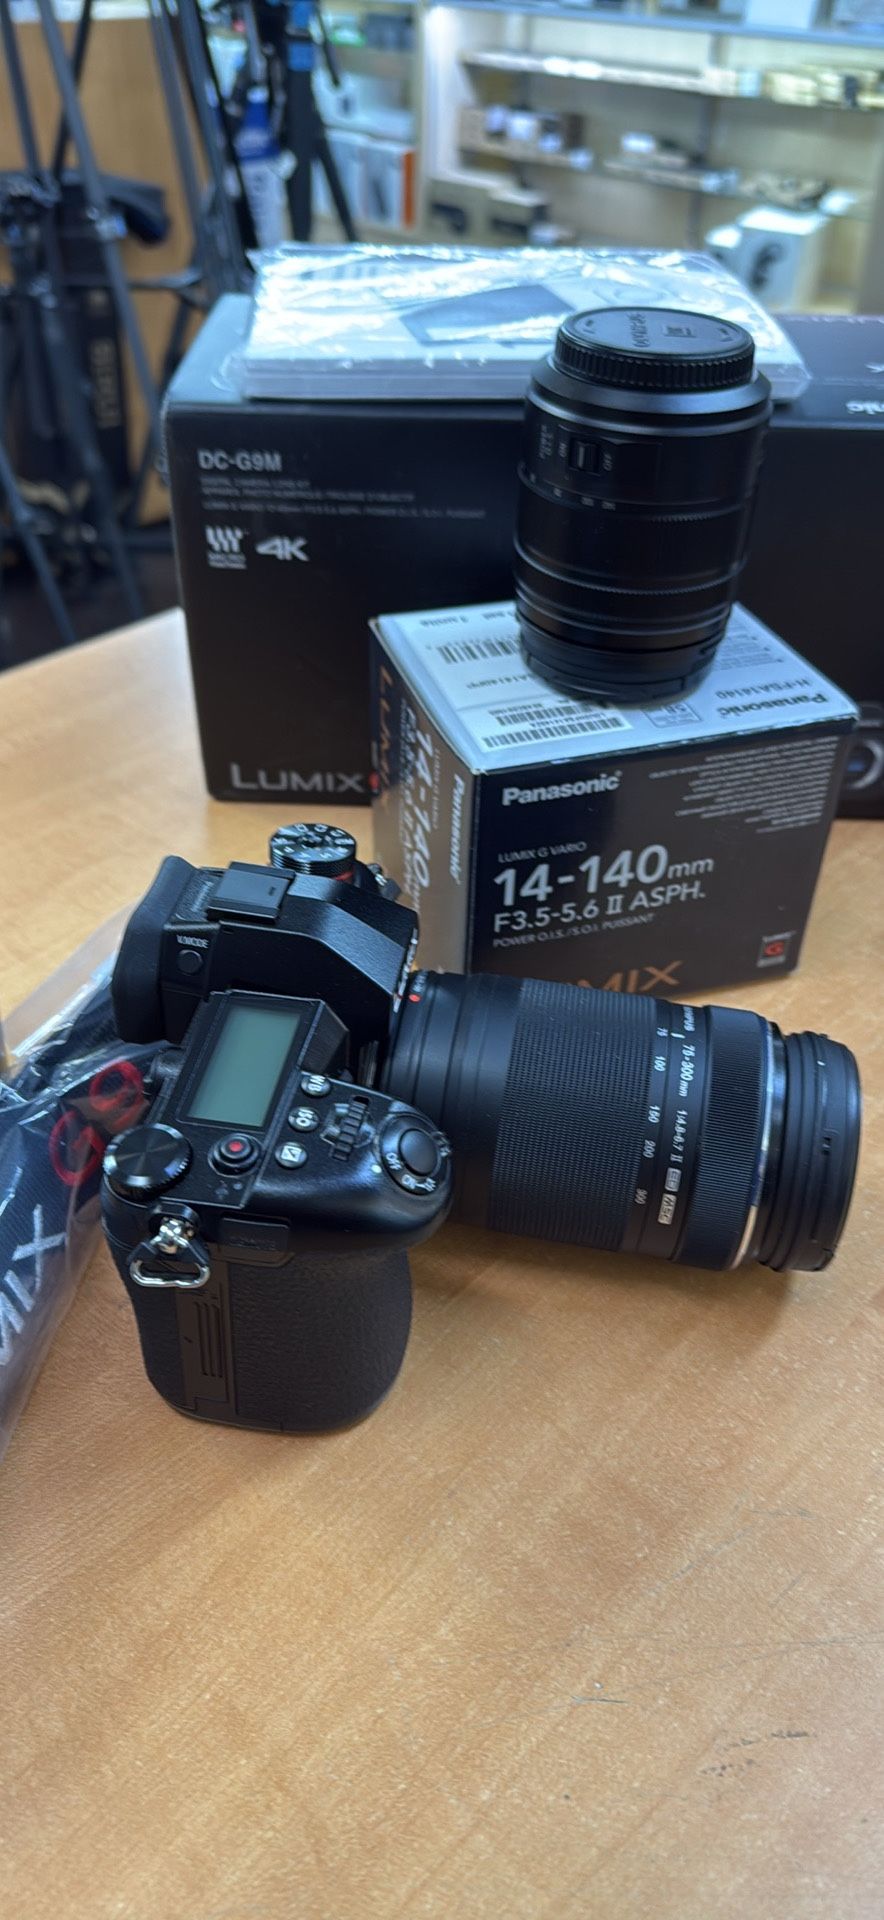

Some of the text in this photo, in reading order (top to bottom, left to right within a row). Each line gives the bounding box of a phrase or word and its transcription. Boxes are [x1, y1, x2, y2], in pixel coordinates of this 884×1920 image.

[199, 451, 283, 471] DC-G9M
[255, 536, 309, 561] 4K
[716, 693, 828, 718] Panasonic
[229, 762, 365, 793] LUMIX
[502, 773, 621, 806] Panasonic
[450, 773, 465, 883] Panasonic
[498, 848, 536, 863] LUMIX
[550, 841, 588, 856] VARIO
[494, 844, 714, 907] 14-140mm
[493, 898, 600, 933] F3.5-5.6
[628, 880, 706, 911] ASPH.
[493, 932, 536, 948] POWER
[603, 912, 655, 930] PUISSANT
[654, 1055, 667, 1072] 100
[678, 1044, 696, 1098] 75-300mm
[307, 1074, 327, 1091] WB
[296, 1109, 315, 1127] ISO
[648, 1105, 661, 1123] 150
[642, 1139, 656, 1159] 200
[386, 1152, 402, 1170] OFF
[634, 1188, 648, 1205] 300
